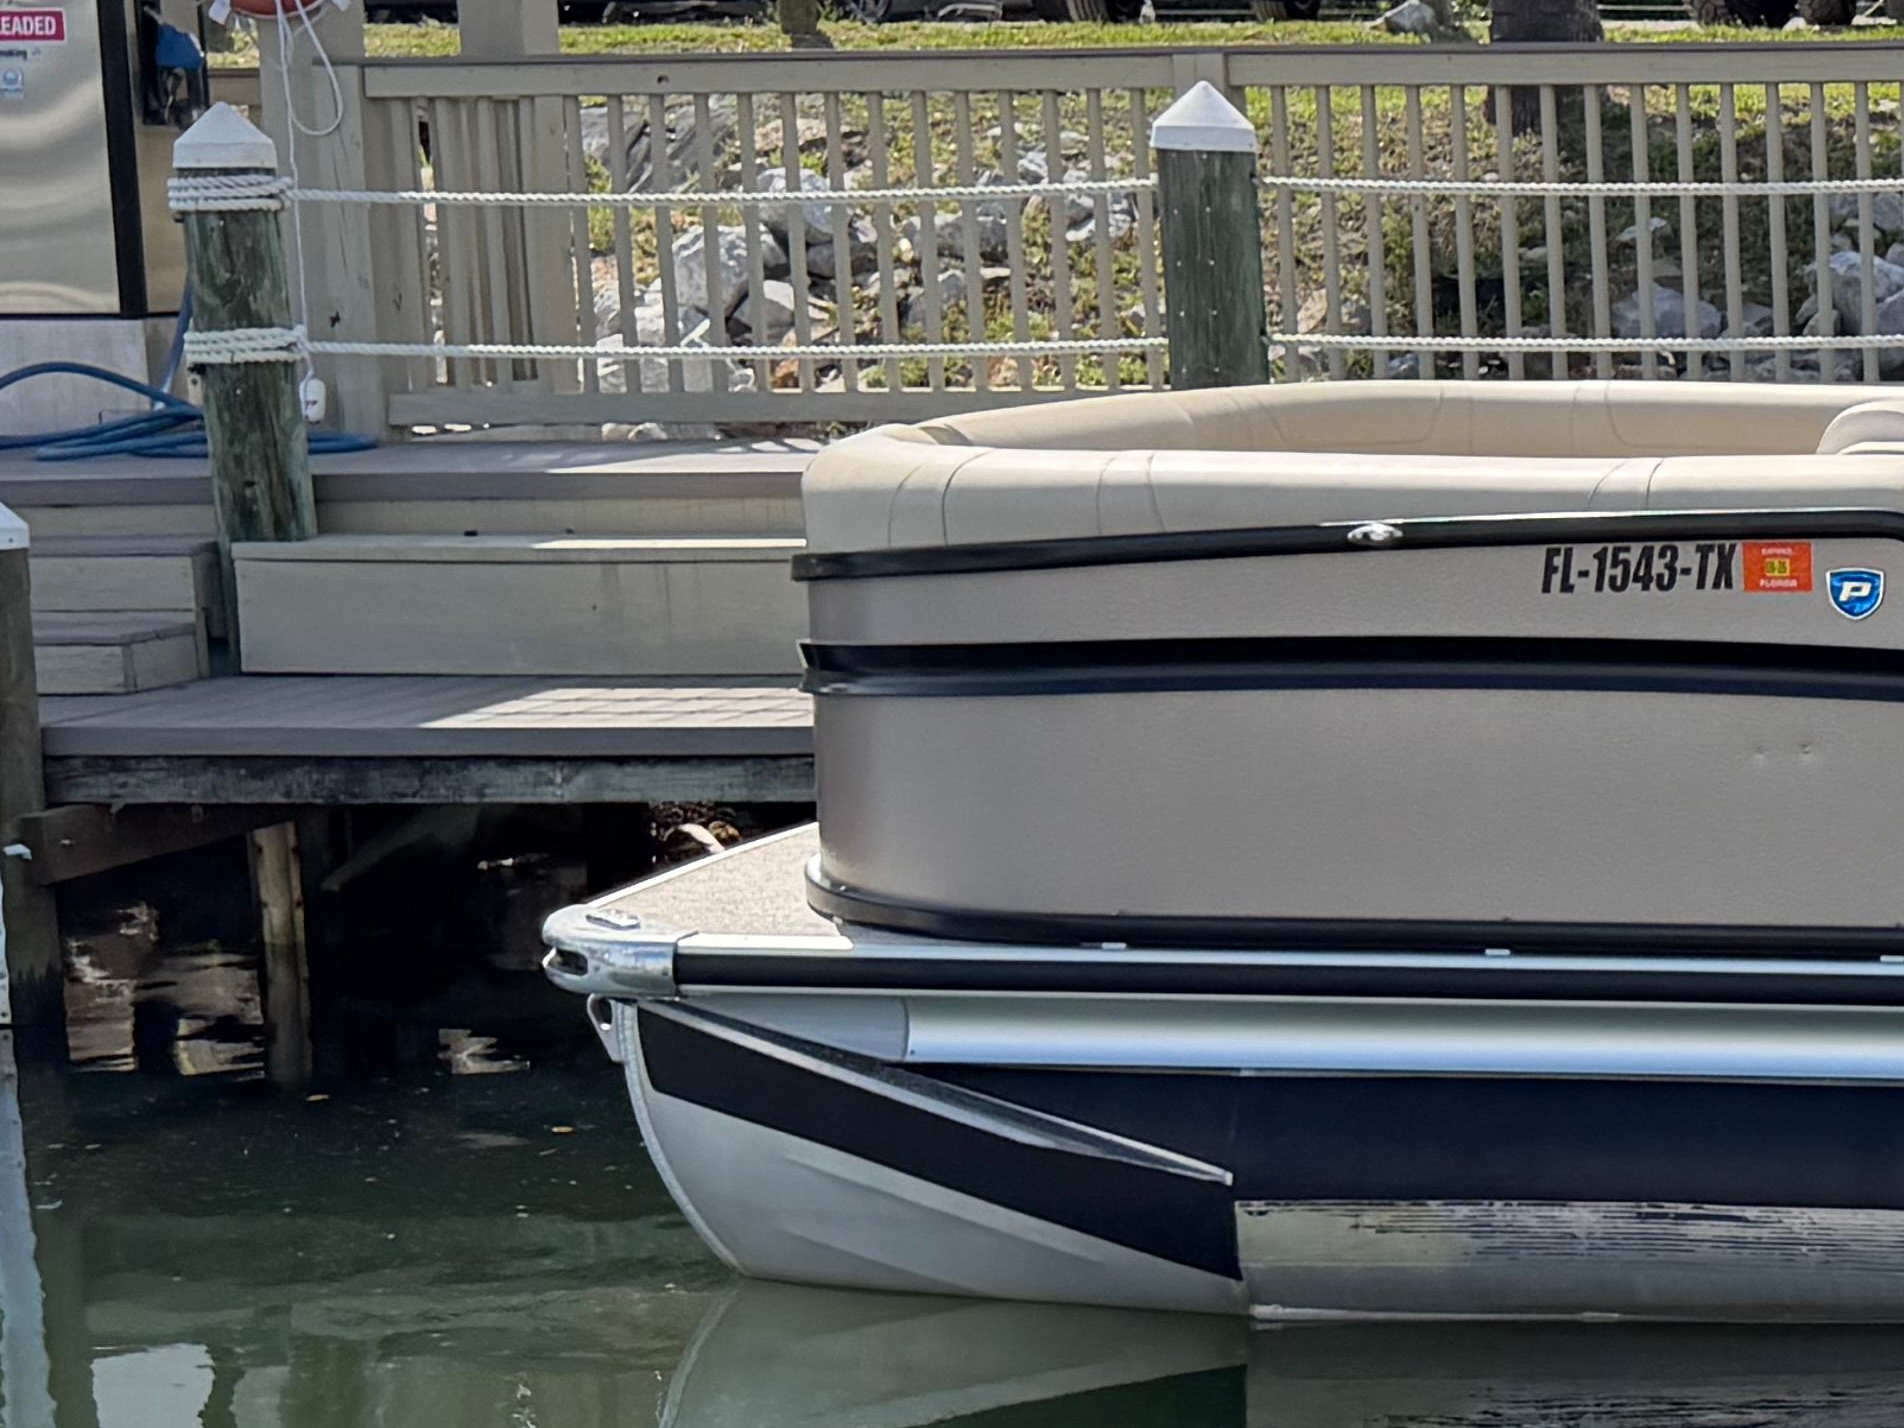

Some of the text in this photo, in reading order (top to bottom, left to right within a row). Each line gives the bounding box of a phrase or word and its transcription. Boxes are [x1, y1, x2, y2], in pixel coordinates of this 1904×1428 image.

[0, 15, 57, 37] EADED
[1541, 542, 1737, 594] FL-1543-TX
[1839, 581, 1873, 602] P
